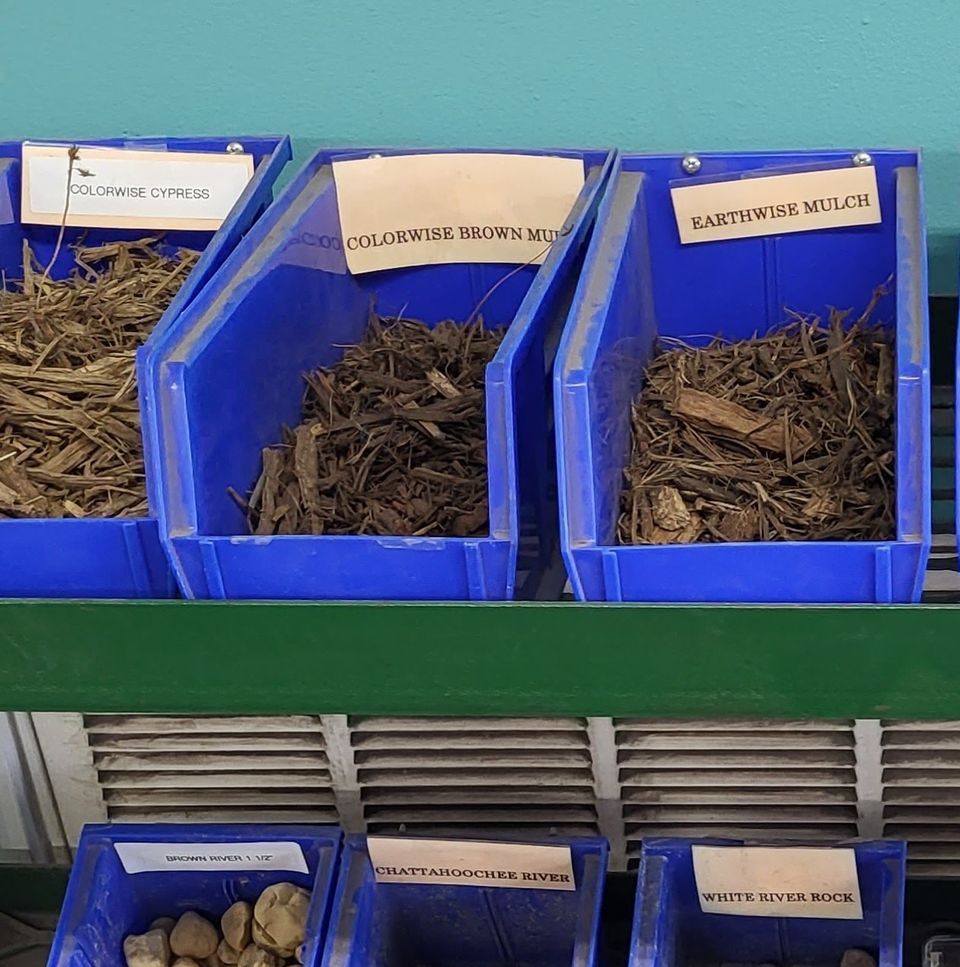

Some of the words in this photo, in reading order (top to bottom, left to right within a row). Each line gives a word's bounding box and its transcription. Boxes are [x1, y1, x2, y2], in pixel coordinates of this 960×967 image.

[70, 183, 147, 199] COLORWISE
[150, 187, 210, 200] CYPRESS
[690, 202, 800, 231] EARTHWISE
[803, 193, 871, 215] MULCH
[346, 226, 455, 251] COLORWISE
[459, 226, 523, 240] BROWN
[375, 866, 518, 881] CHATTAHOOCHEE
[521, 872, 571, 883] RIVER
[702, 892, 755, 903] WHITE
[759, 893, 806, 903] RIVER
[810, 893, 855, 903] ROCK
